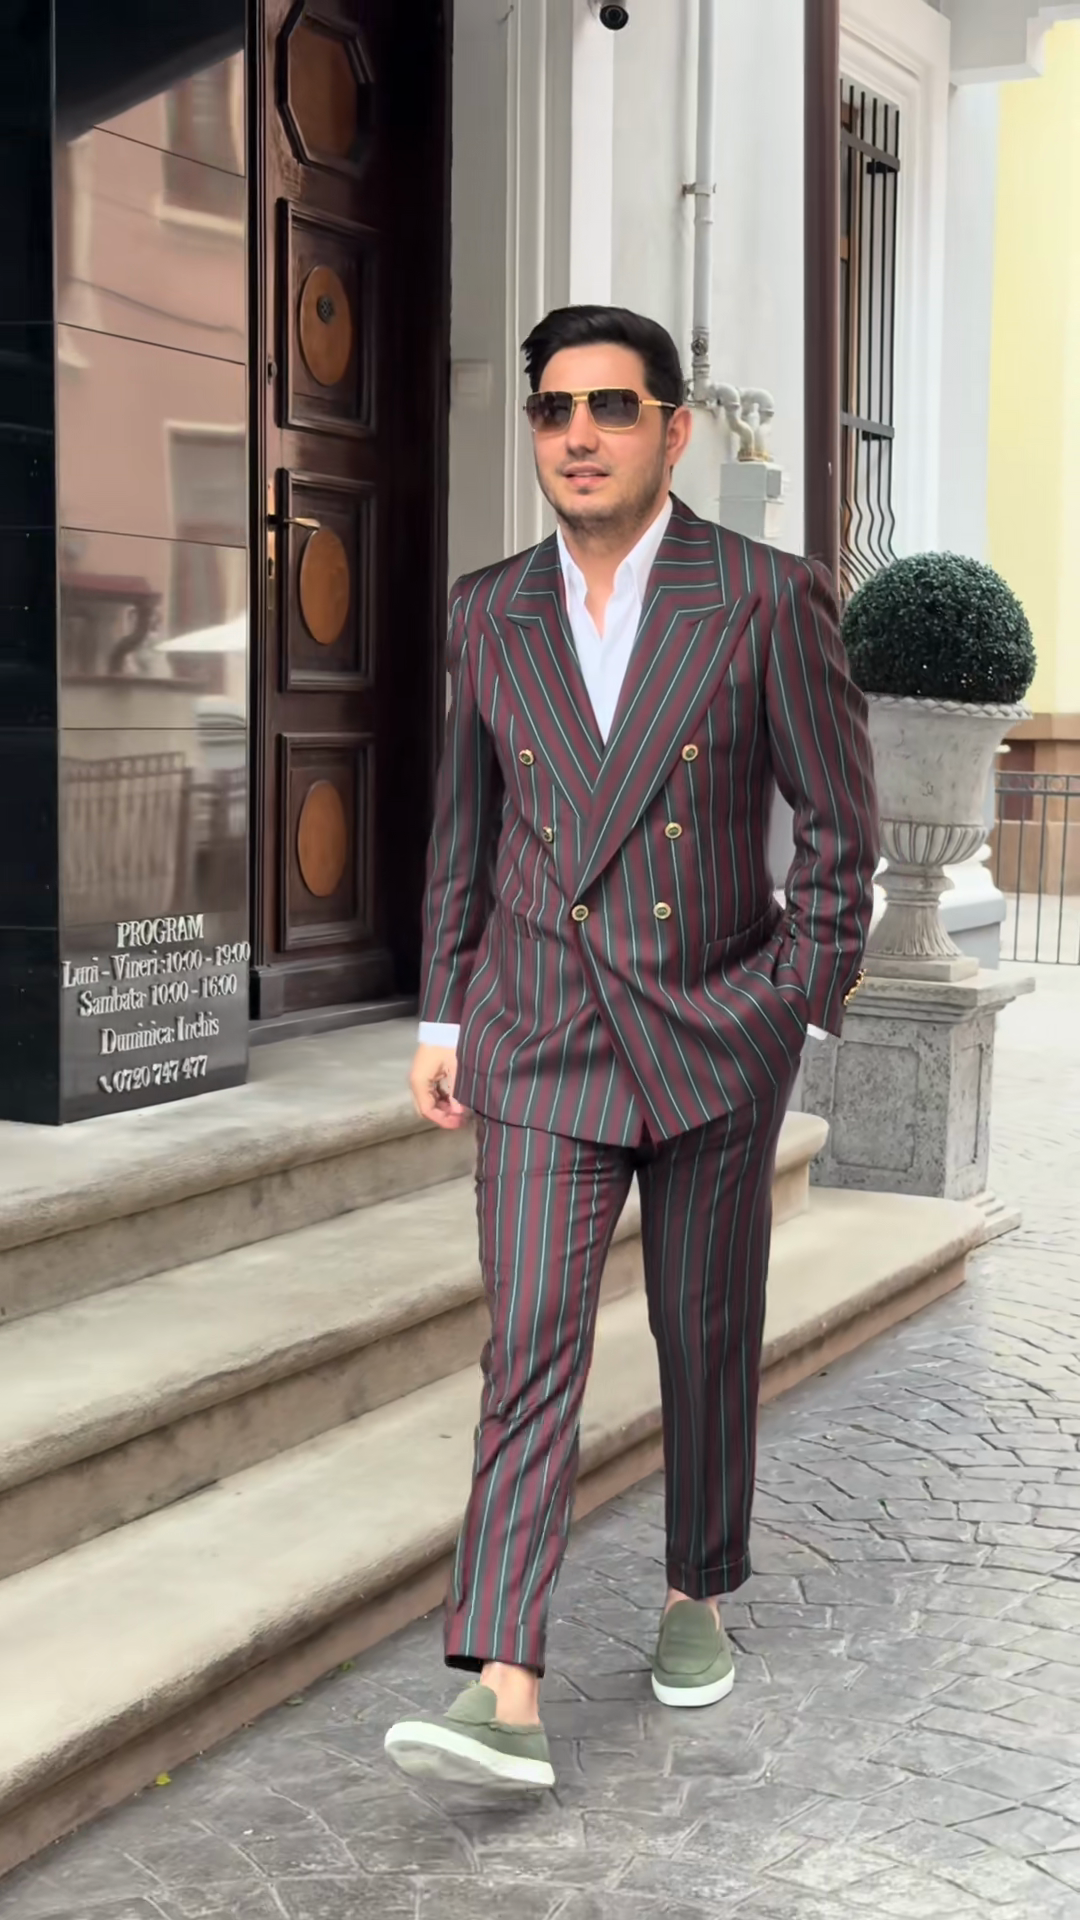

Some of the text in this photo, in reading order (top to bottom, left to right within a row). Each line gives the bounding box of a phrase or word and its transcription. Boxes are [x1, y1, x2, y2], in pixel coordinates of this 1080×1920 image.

[116, 914, 204, 948] PROGRAM
[62, 956, 99, 988] Luni
[215, 942, 251, 965] 19:00
[150, 983, 189, 1005] 10:00
[202, 974, 237, 998] 16:00
[177, 1011, 220, 1041] Inchis
[113, 1055, 208, 1092] 0720 747 477
